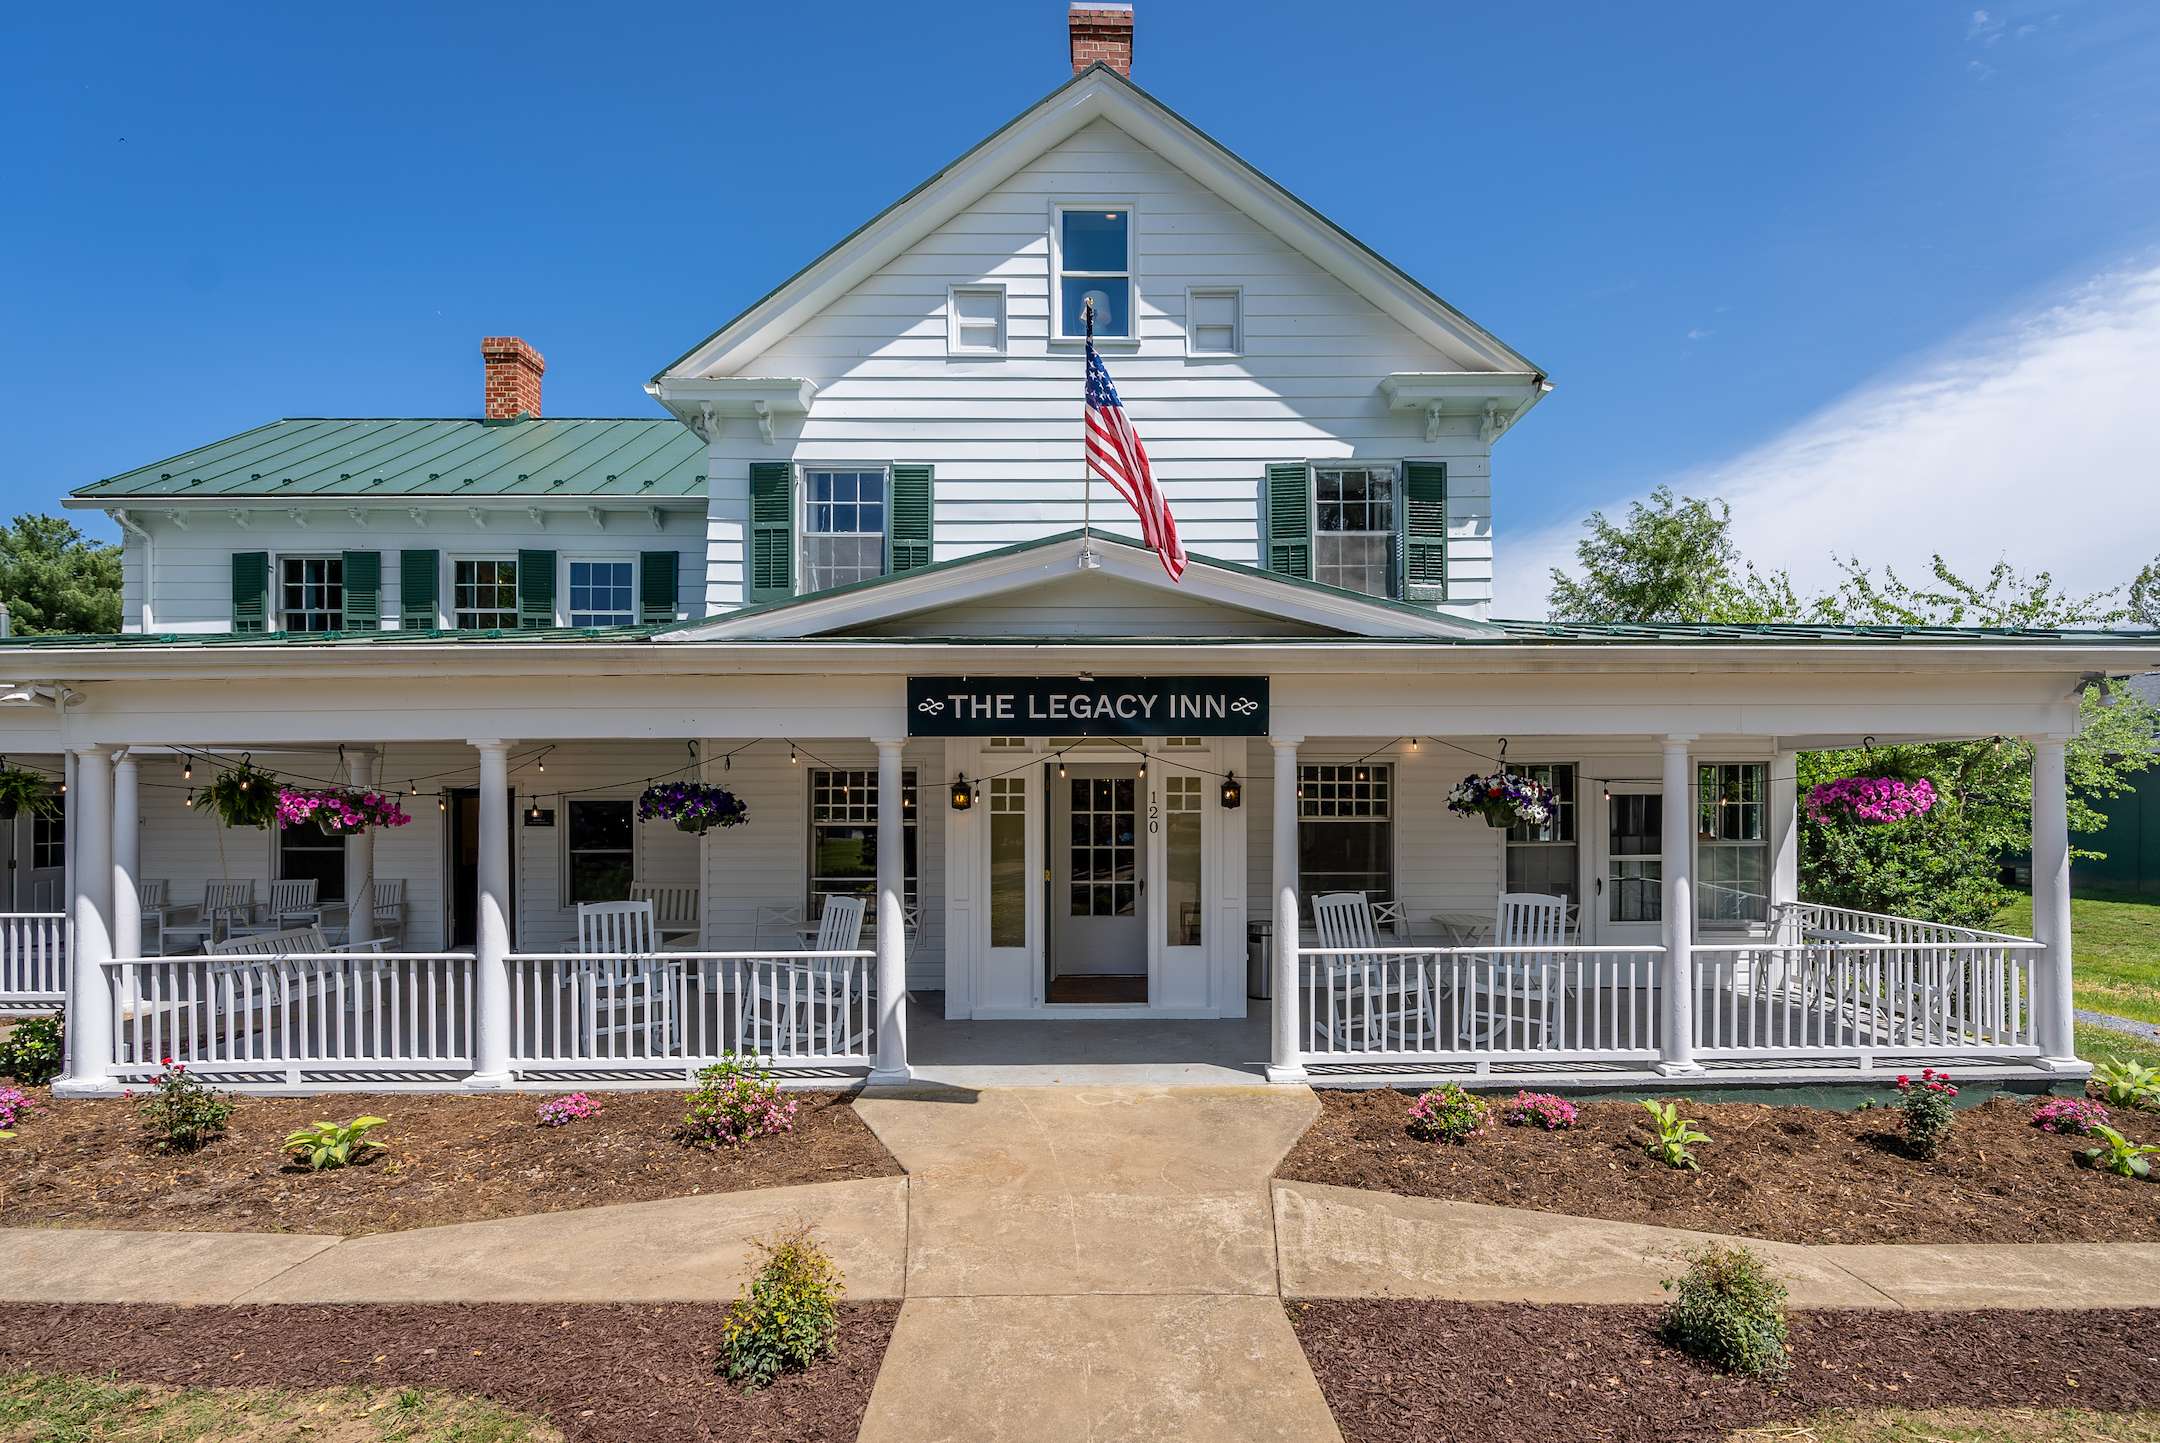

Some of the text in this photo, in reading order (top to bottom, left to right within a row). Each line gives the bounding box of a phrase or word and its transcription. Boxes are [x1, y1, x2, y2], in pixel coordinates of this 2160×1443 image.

[947, 694, 1226, 719] THE LEGACY INN
[1149, 791, 1159, 834] 120
